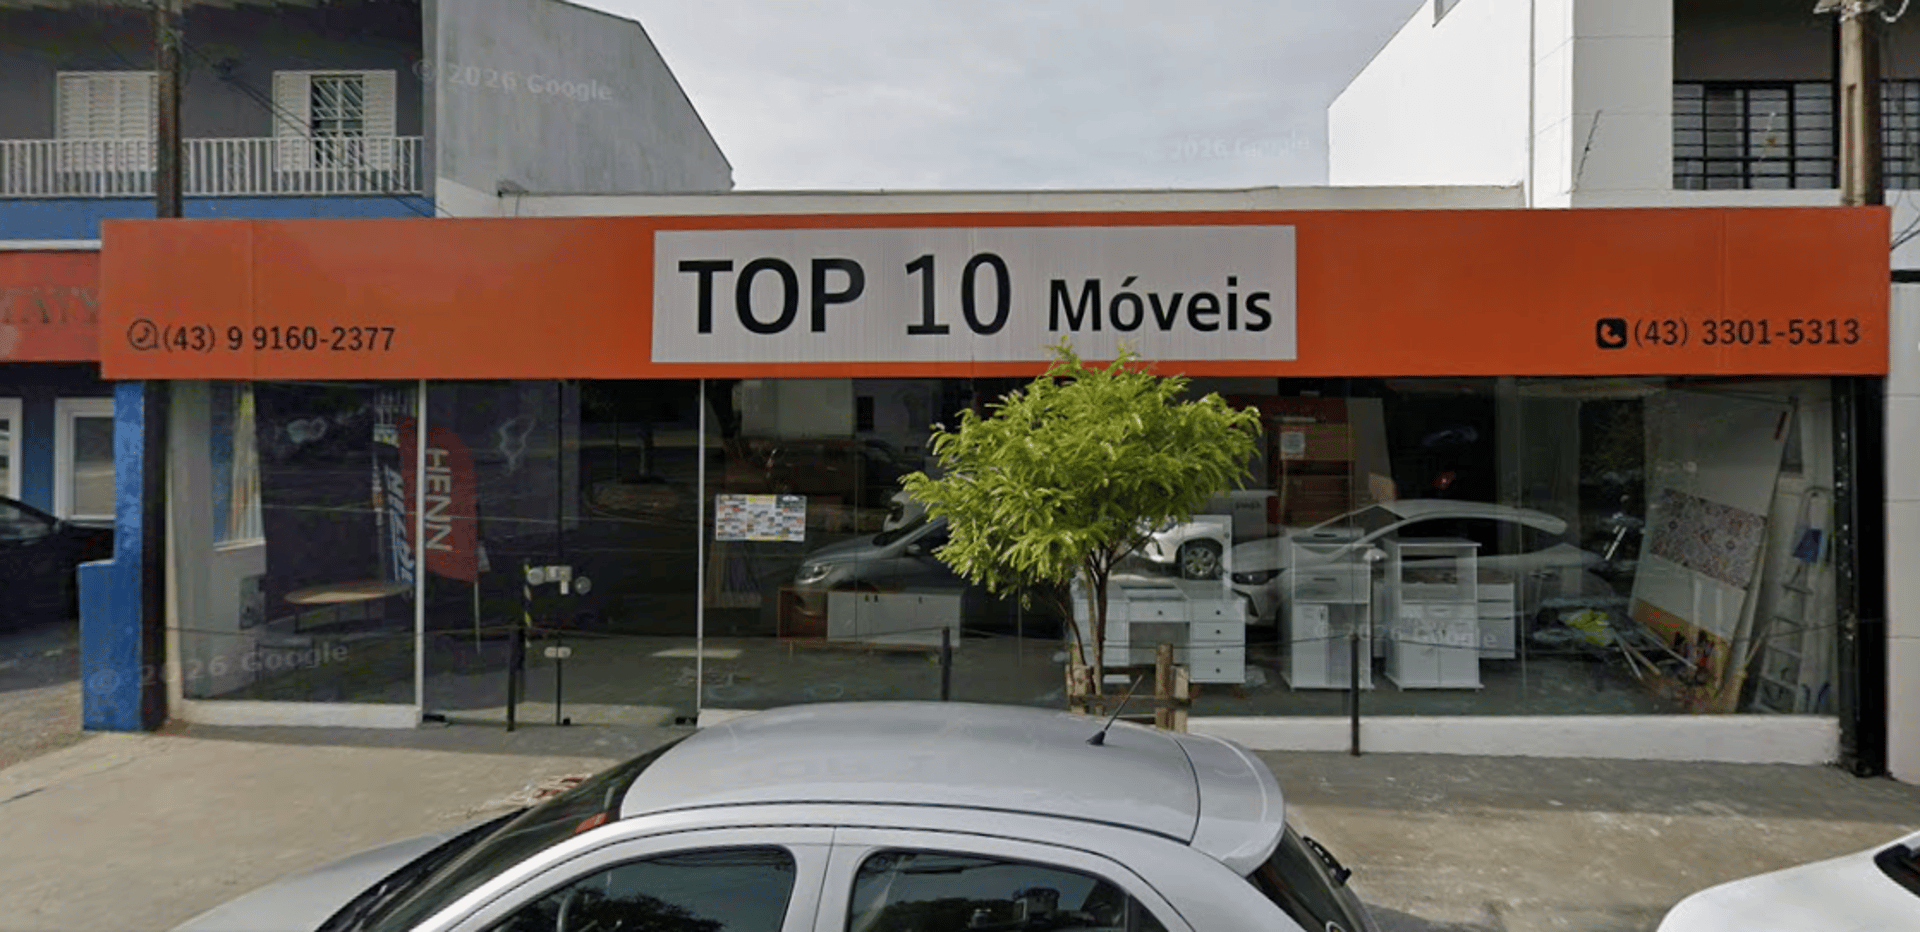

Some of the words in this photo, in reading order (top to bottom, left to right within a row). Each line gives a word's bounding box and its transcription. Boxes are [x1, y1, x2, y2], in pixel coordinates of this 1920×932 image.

[678, 257, 866, 336] TOP
[904, 252, 1012, 336] 10
[1048, 276, 1273, 333] Móveis
[163, 324, 215, 353] (43)
[227, 325, 243, 351] 9
[252, 325, 396, 351] 9160-2377
[1634, 317, 1688, 348] (43)
[1702, 318, 1861, 346] 3301-5313
[424, 448, 453, 551] HENN
